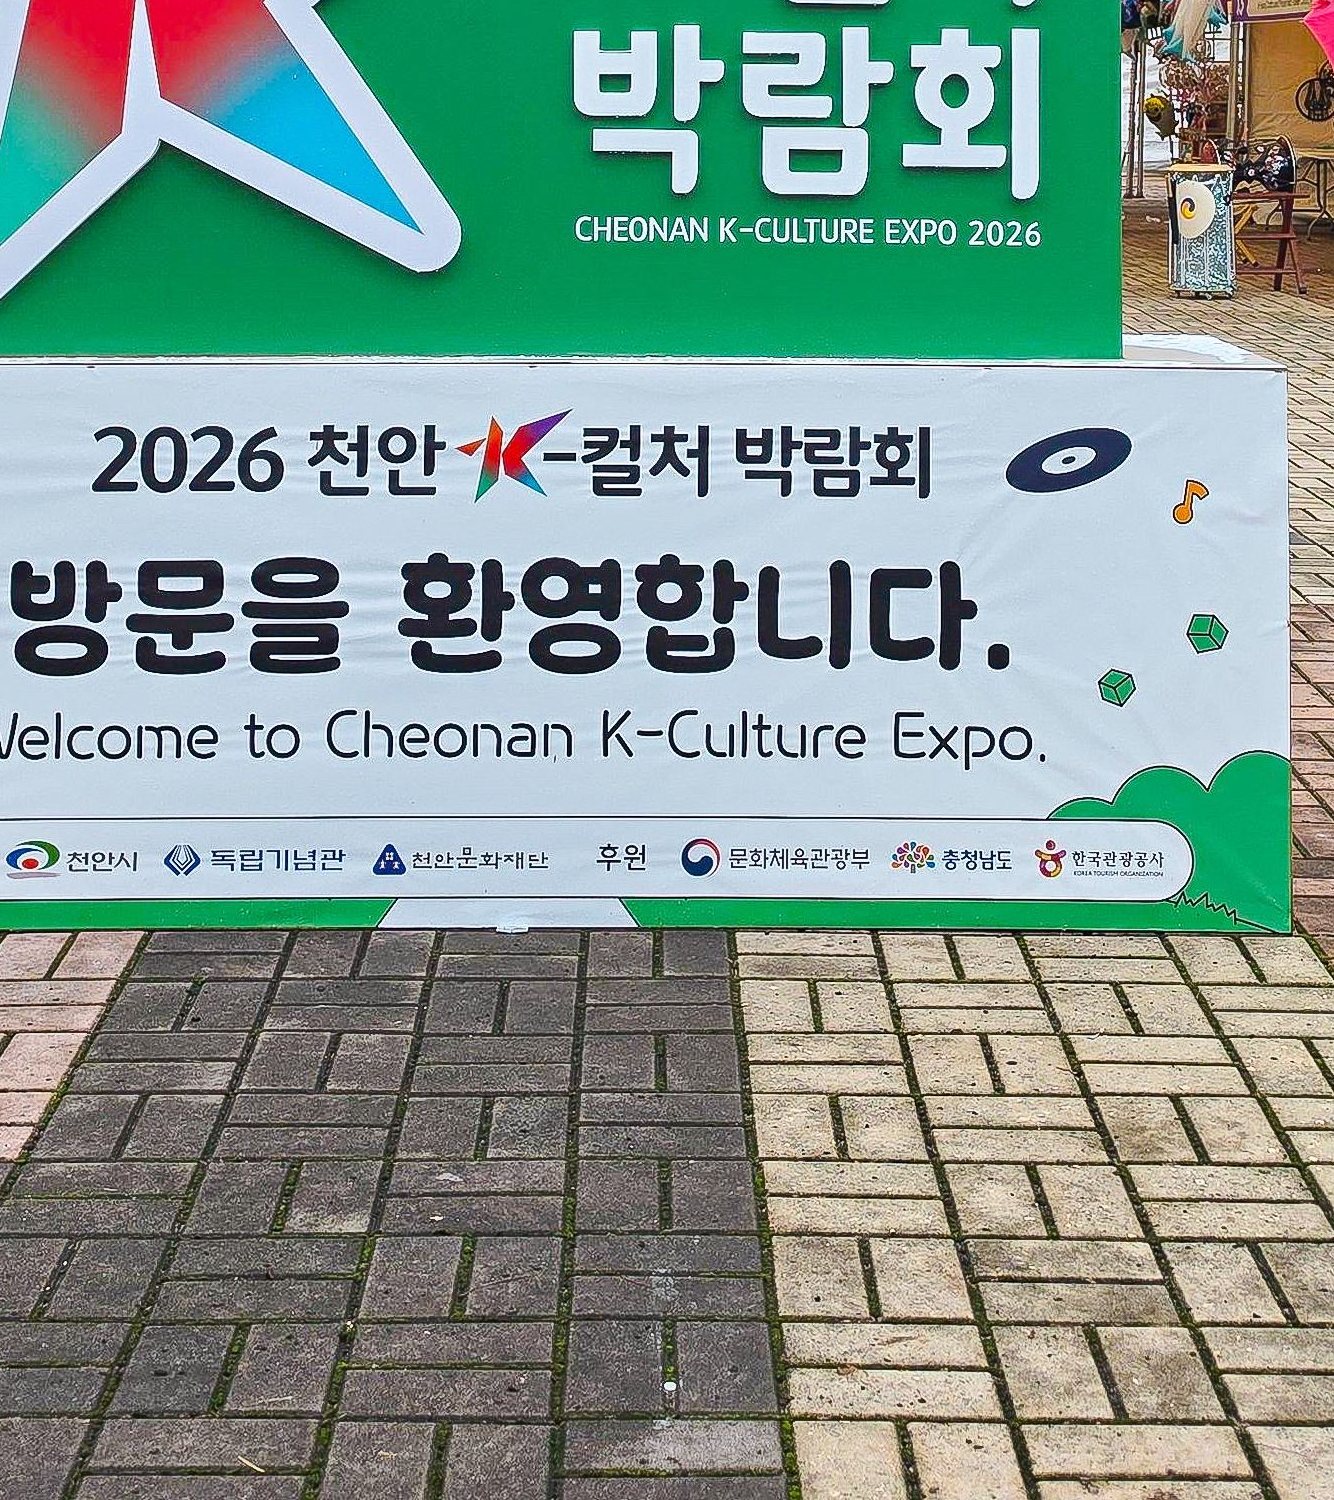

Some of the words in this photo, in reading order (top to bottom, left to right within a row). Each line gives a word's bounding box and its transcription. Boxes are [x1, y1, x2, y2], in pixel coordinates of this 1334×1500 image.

[573, 24, 1040, 200] 박람회
[575, 215, 709, 244] CHEONAN
[719, 216, 874, 245] K-CULTURE
[885, 218, 957, 245] EXPO
[968, 219, 1042, 247] 2026
[91, 425, 285, 494] 2026
[307, 424, 447, 497] 천안
[735, 425, 931, 500] 박람회
[10, 556, 350, 677] 방문을
[397, 552, 1010, 675] 환영합니다.
[243, 713, 301, 759] to
[326, 709, 573, 760] Cheonan
[602, 709, 867, 760] K-Culture
[893, 711, 1046, 771] Expo.
[66, 851, 138, 873] 천안시
[210, 849, 347, 873] 독립기념관
[411, 846, 549, 870] 천안문화재단
[596, 843, 647, 872] 후원
[728, 848, 871, 871] 문화체육관광부
[941, 849, 1013, 872] 충청남도
[1071, 850, 1165, 869] 한국관광공사
